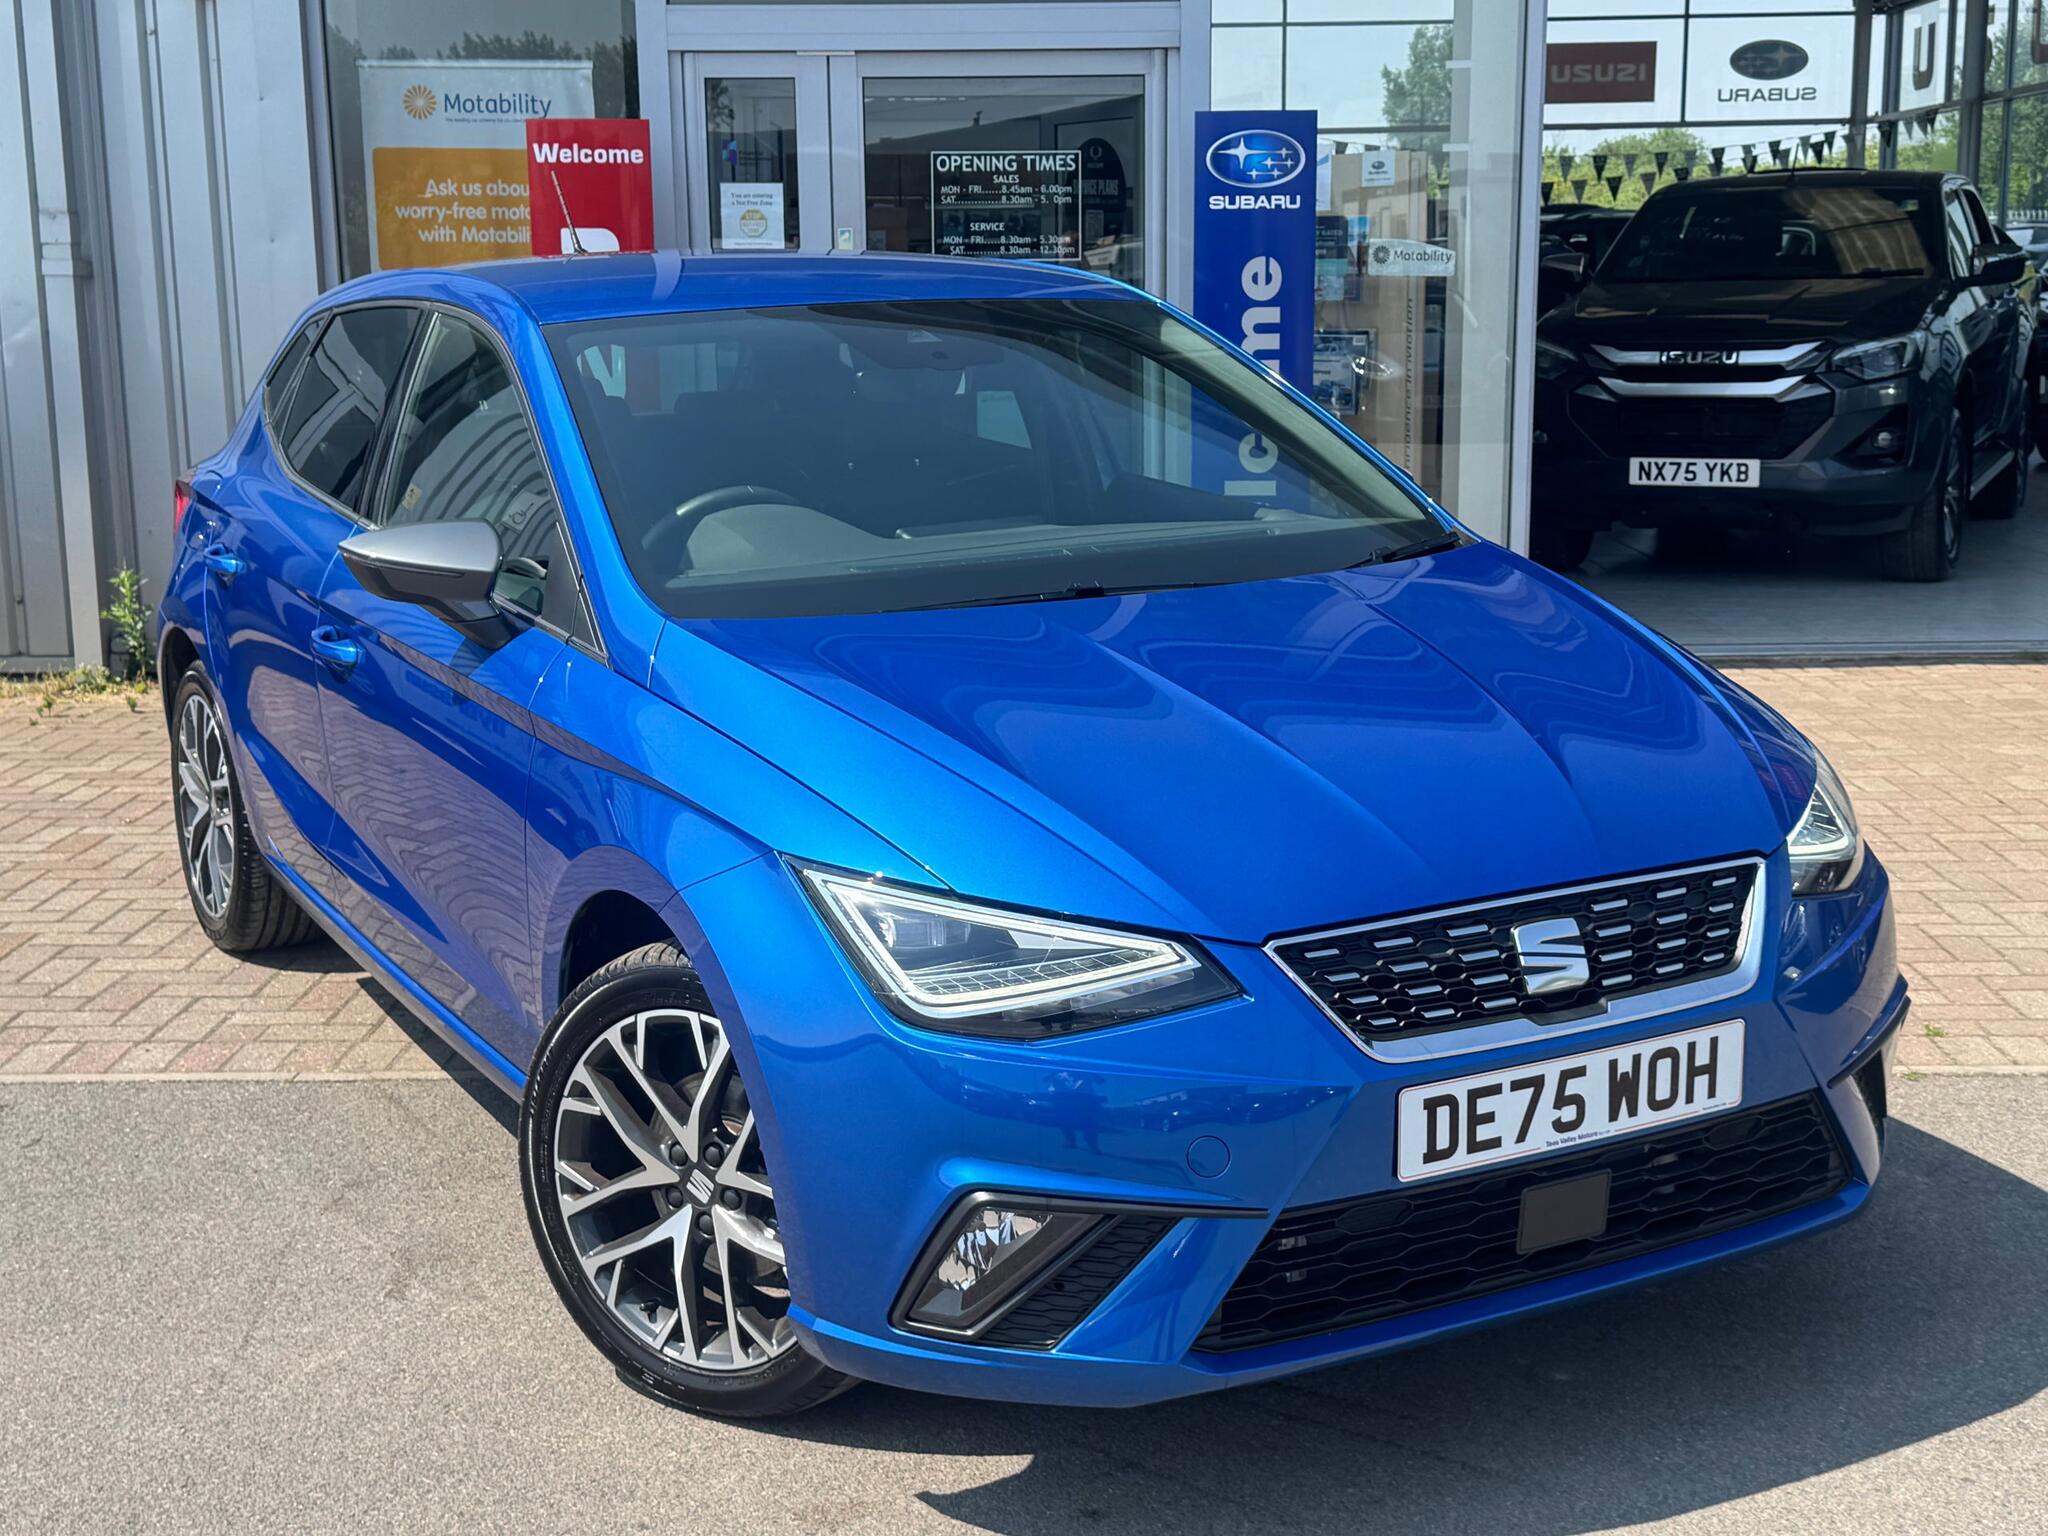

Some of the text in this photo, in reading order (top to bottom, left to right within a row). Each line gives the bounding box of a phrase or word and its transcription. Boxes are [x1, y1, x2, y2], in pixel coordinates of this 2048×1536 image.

[444, 93, 551, 119] Motability
[533, 143, 644, 164] Welcome
[936, 155, 1076, 172] OPENING TIMES
[993, 175, 1019, 183] SALES
[426, 179, 529, 196] Ask us abou
[941, 185, 960, 194] MON
[1209, 195, 1301, 210] SUBARU
[395, 203, 530, 222] worry-free moto
[970, 222, 1005, 231] SERVICE
[418, 227, 530, 243] with Motabili
[943, 236, 962, 244] MON
[1393, 250, 1452, 263] Motability
[1661, 350, 1737, 364] ISUZU
[1638, 460, 1750, 484] NX75 YKB
[1423, 1036, 1719, 1165] DE75 WOH
